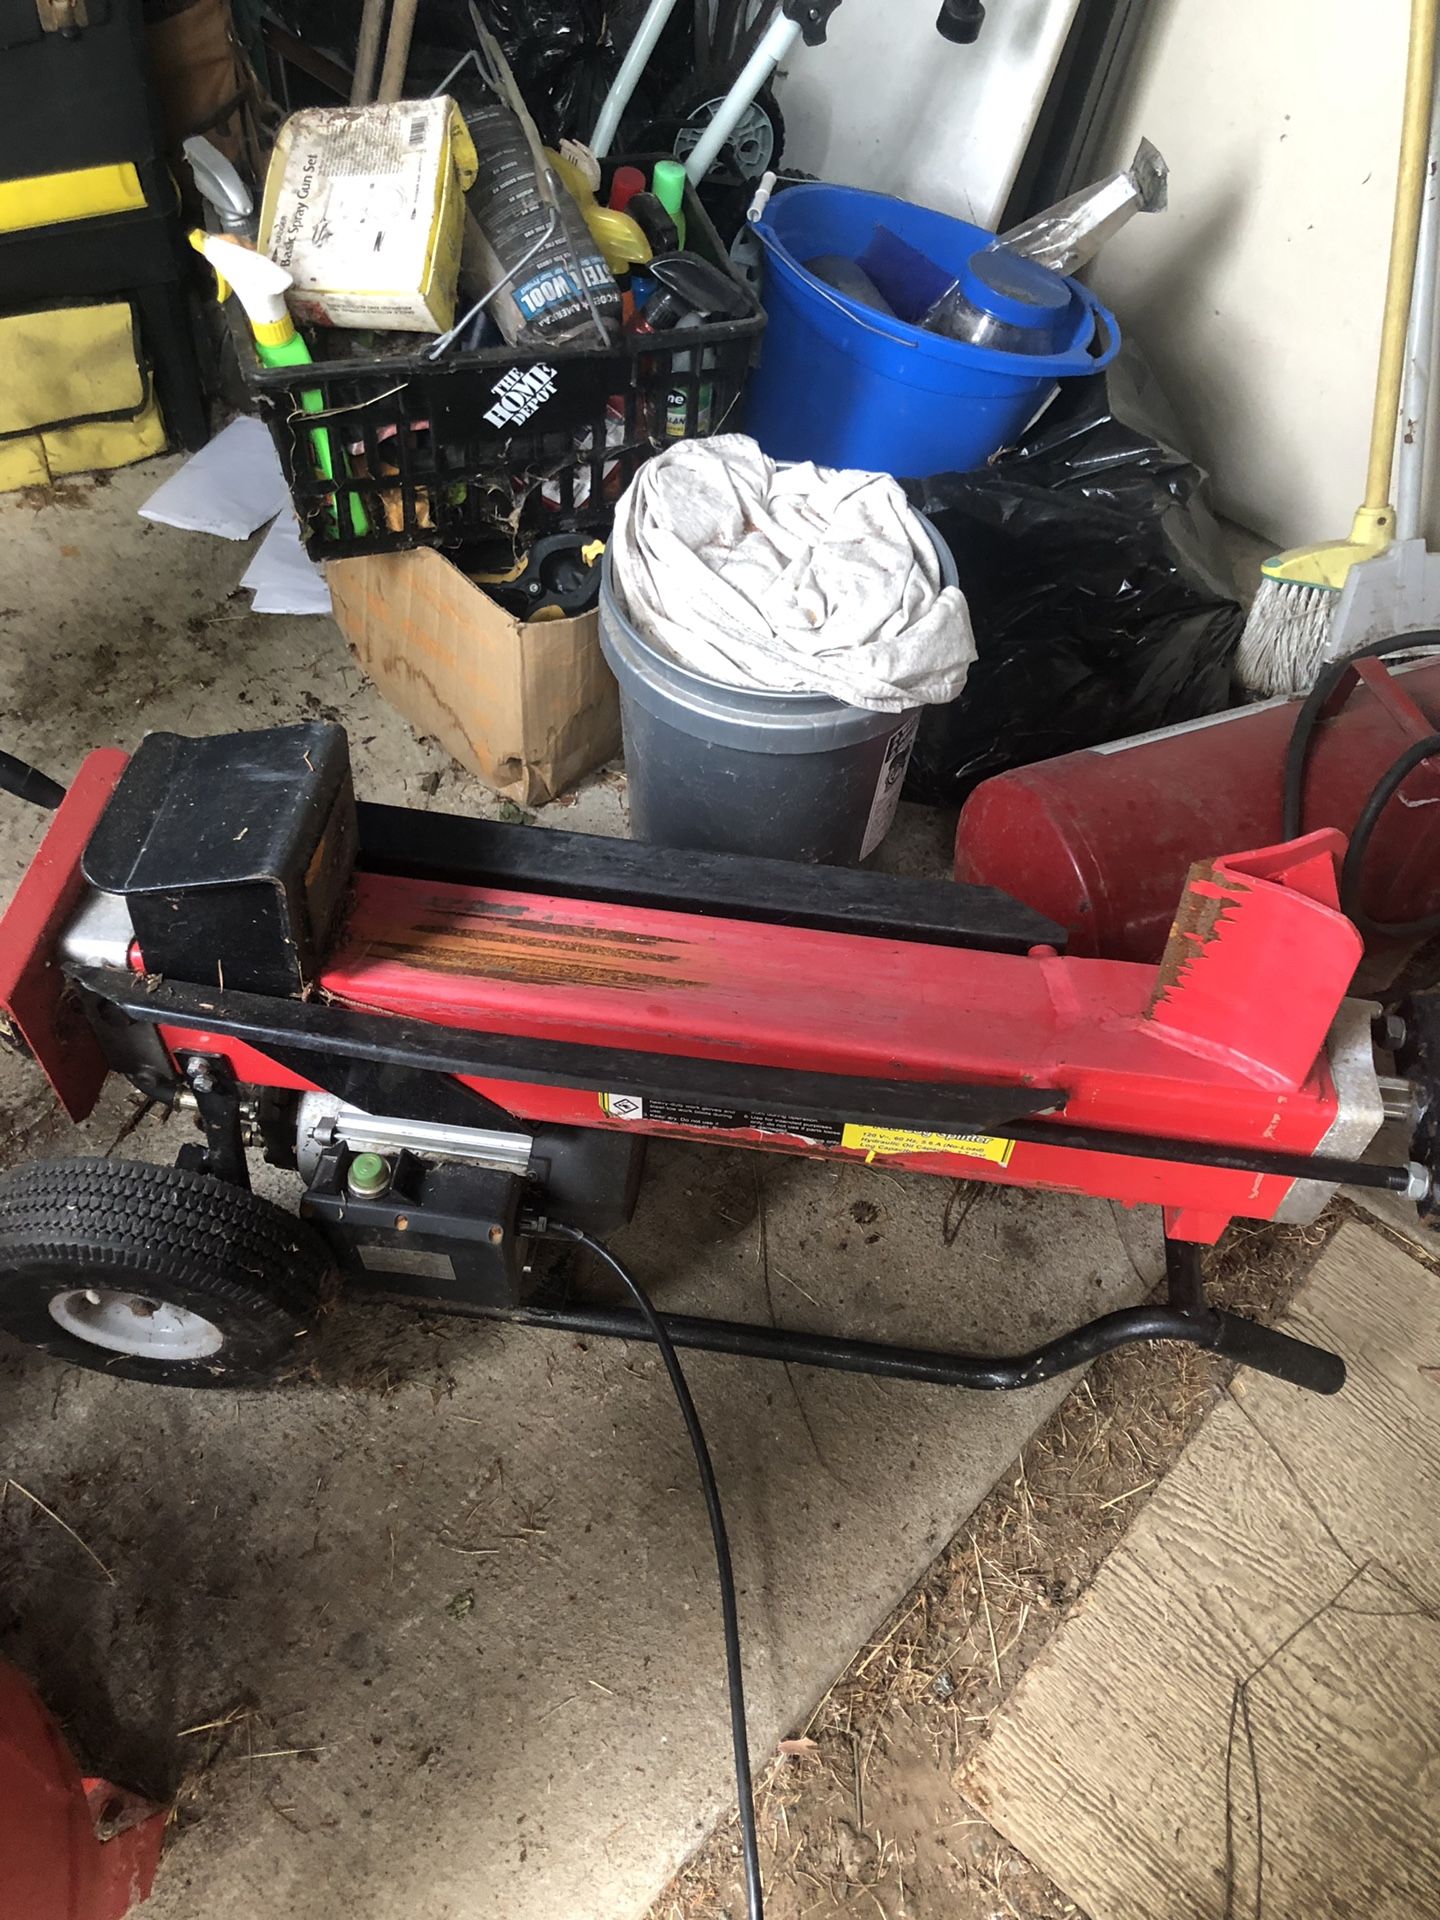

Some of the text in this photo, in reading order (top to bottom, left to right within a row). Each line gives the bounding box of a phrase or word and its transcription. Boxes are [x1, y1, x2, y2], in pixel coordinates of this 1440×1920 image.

[303, 154, 318, 172] Set
[297, 175, 312, 199] Gun
[288, 202, 309, 234] Spray
[280, 236, 296, 267] Basic
[520, 275, 572, 313] WOOL
[482, 362, 558, 429] HOME
[490, 366, 524, 397] THE
[510, 381, 558, 427] DEPOT
